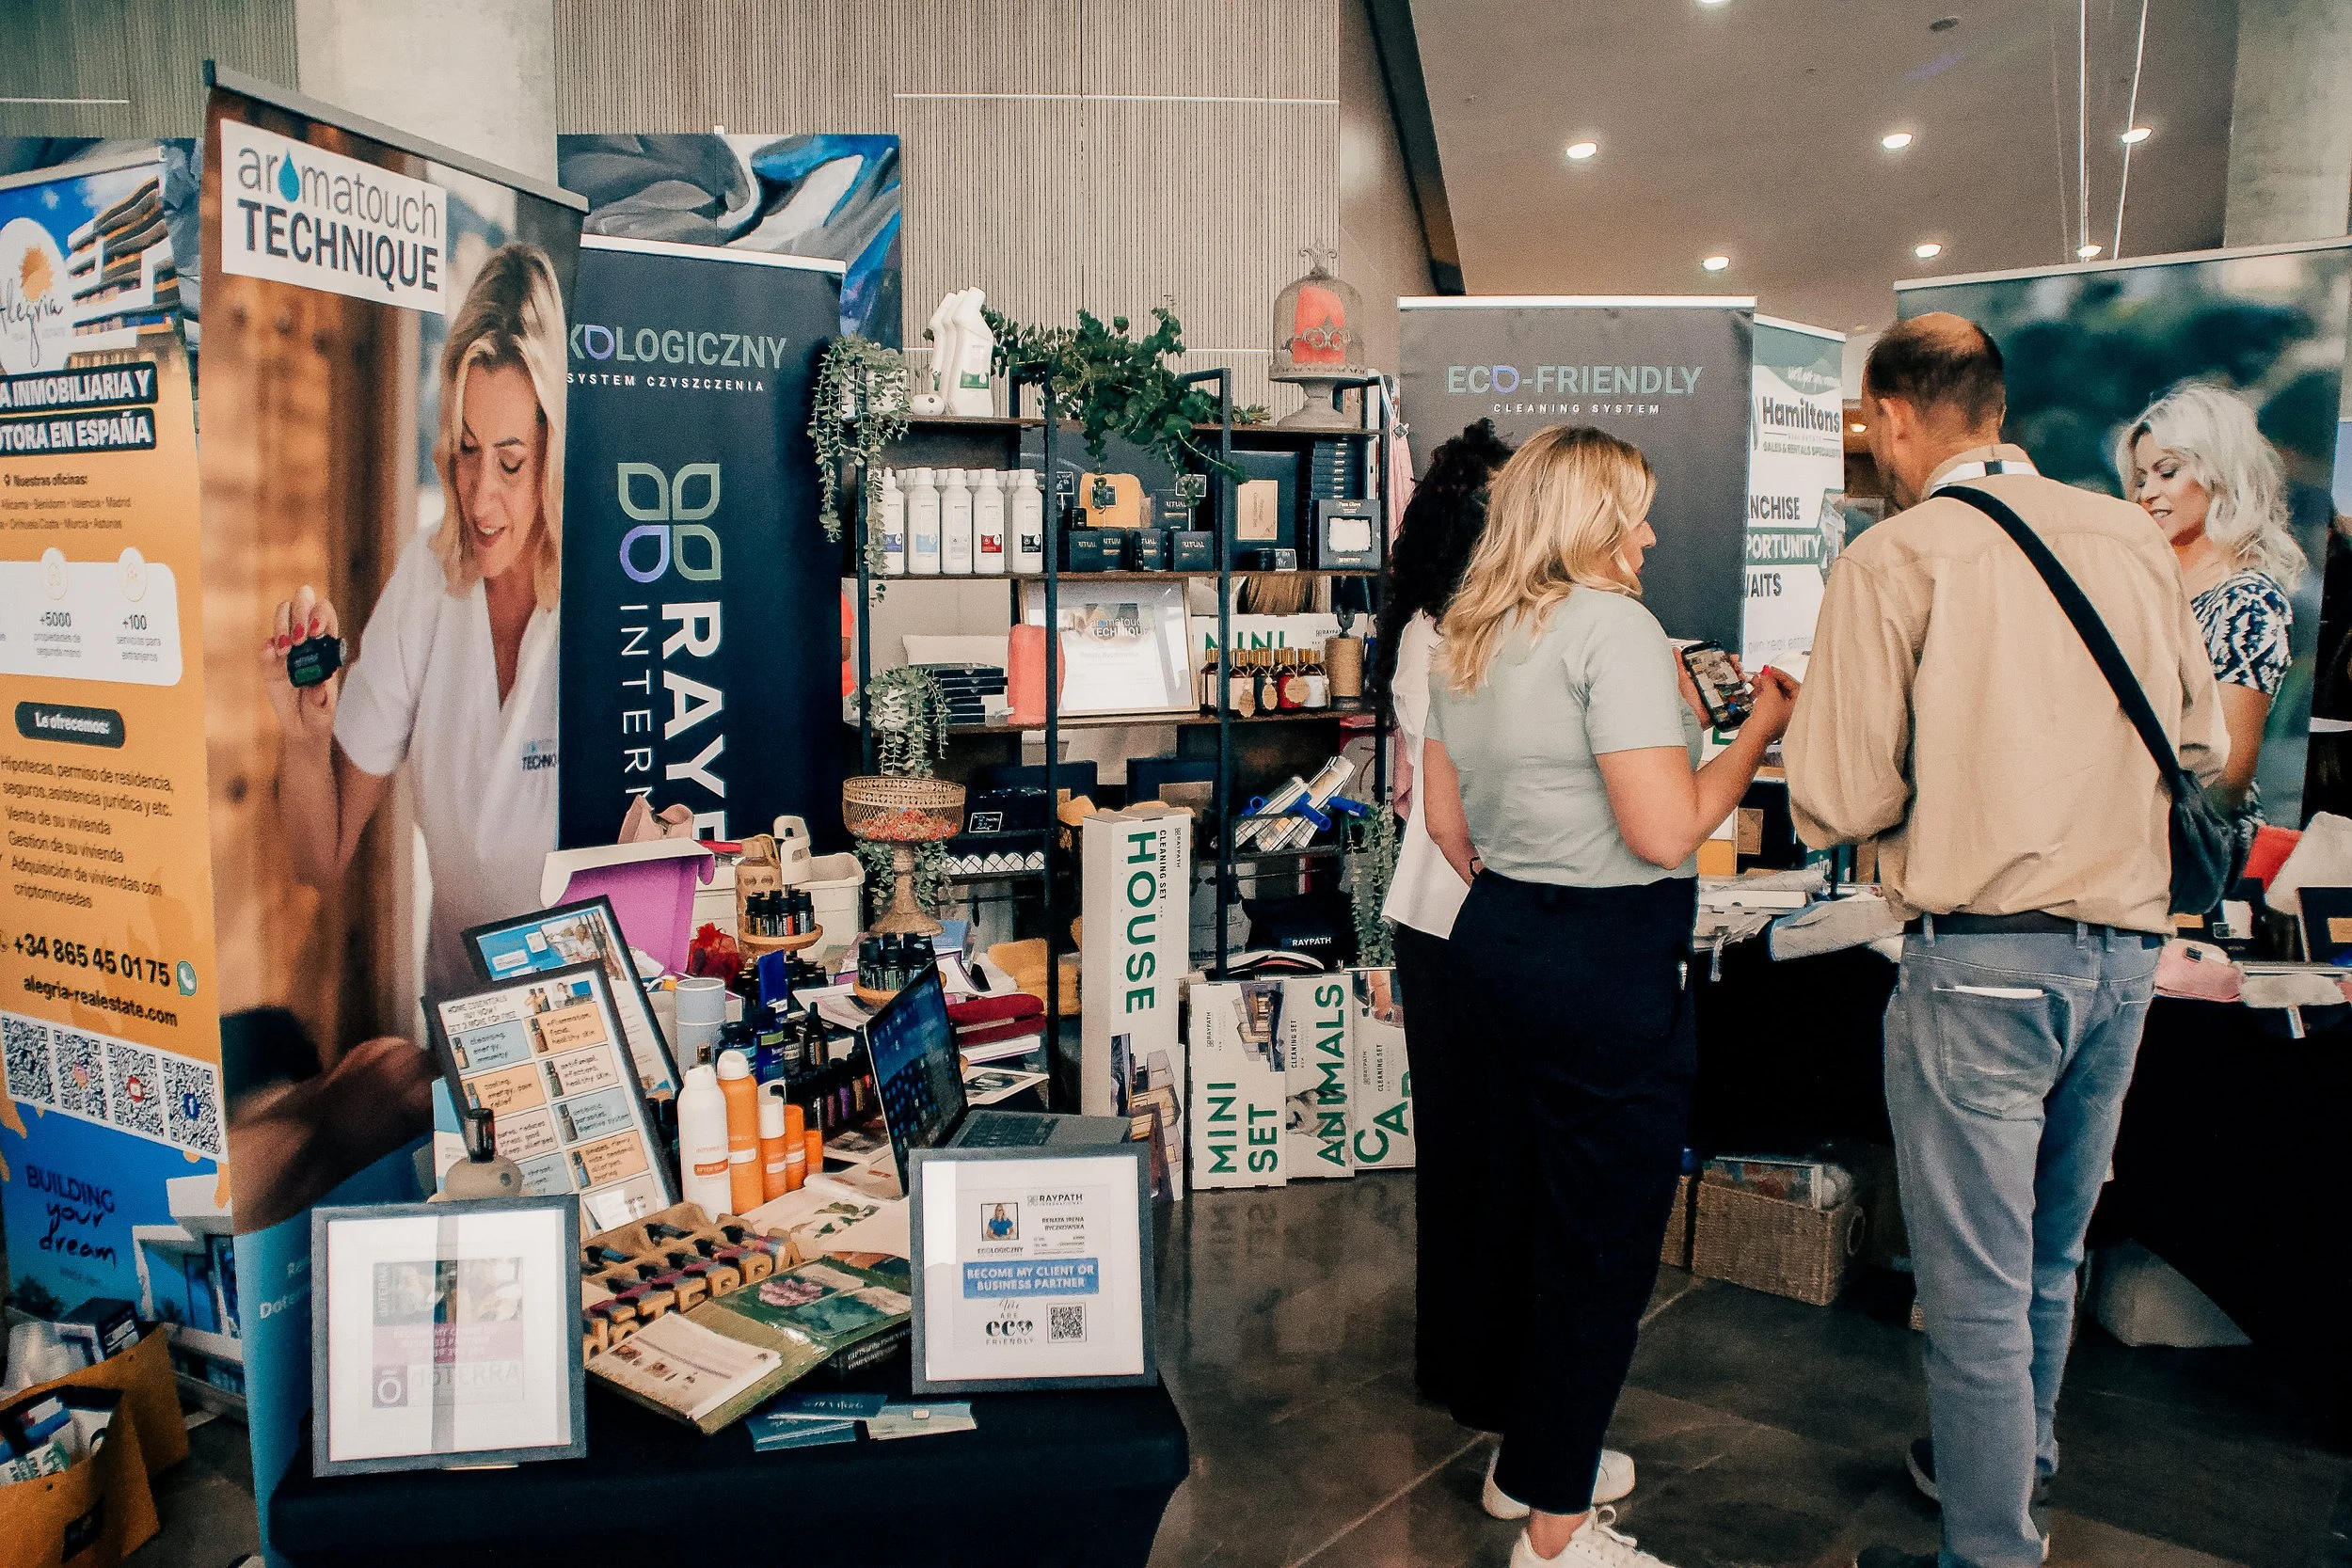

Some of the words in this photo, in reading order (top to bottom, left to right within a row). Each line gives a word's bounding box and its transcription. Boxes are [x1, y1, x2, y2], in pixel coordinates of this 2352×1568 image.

[237, 147, 439, 238] aromatouch
[237, 198, 438, 292] TECHNIQUE
[12, 371, 135, 406] INMOBILIARIA
[135, 369, 151, 396] Y
[566, 372, 635, 387] SYSTEM
[646, 376, 764, 391] CZYSZCZENIA
[1447, 364, 1703, 395] ECO-FRIENDLY
[1493, 403, 1581, 414] CLEANING
[1592, 404, 1661, 414] SYSTEM
[1762, 396, 1840, 433] Hamiltons
[0, 424, 51, 451] TORA
[50, 420, 73, 448] EN
[76, 411, 151, 446] ESPAÑA
[13, 475, 51, 486] Nuestras
[40, 611, 72, 627] +5000
[122, 614, 148, 630] +100
[35, 712, 48, 727] Le
[49, 713, 110, 735] ofrecemos:
[57, 764, 99, 782] permiso
[100, 768, 114, 784] de
[115, 771, 173, 795] residencia,
[48, 785, 101, 806] asistencia
[144, 801, 151, 817] y
[6, 806, 36, 823] Venta
[38, 811, 51, 826] de
[53, 815, 66, 828] su
[67, 815, 111, 835] vivienda
[51, 837, 64, 853] de
[65, 842, 77, 855] su
[80, 843, 123, 863] vivienda
[11, 855, 72, 879] Adquisición
[73, 866, 88, 882] de
[89, 869, 140, 892] viviendas
[141, 881, 163, 896] con
[13, 882, 92, 909] criptomonedas
[1125, 831, 1157, 1014] HOUSE
[13, 933, 49, 958] +34
[52, 939, 88, 968] 865
[92, 947, 117, 974] 45
[1292, 937, 1332, 946] RAYPATH
[23, 974, 179, 1027] alegria-realestate.com
[1315, 983, 1347, 1167] ANIMALS
[1207, 1083, 1237, 1174] MINI
[1248, 1103, 1279, 1174] SET
[26, 1165, 115, 1213] BUILDING
[1040, 1194, 1083, 1202] RAYPATH
[46, 1202, 104, 1228] your
[39, 1224, 116, 1268] dream
[967, 1268, 1013, 1279] BECOME
[1017, 1267, 1033, 1277] MY
[1036, 1265, 1074, 1276] CLIENT
[1077, 1264, 1093, 1275] OR
[977, 1280, 1031, 1291] BUSINESS
[1035, 1278, 1085, 1289] PARTNER
